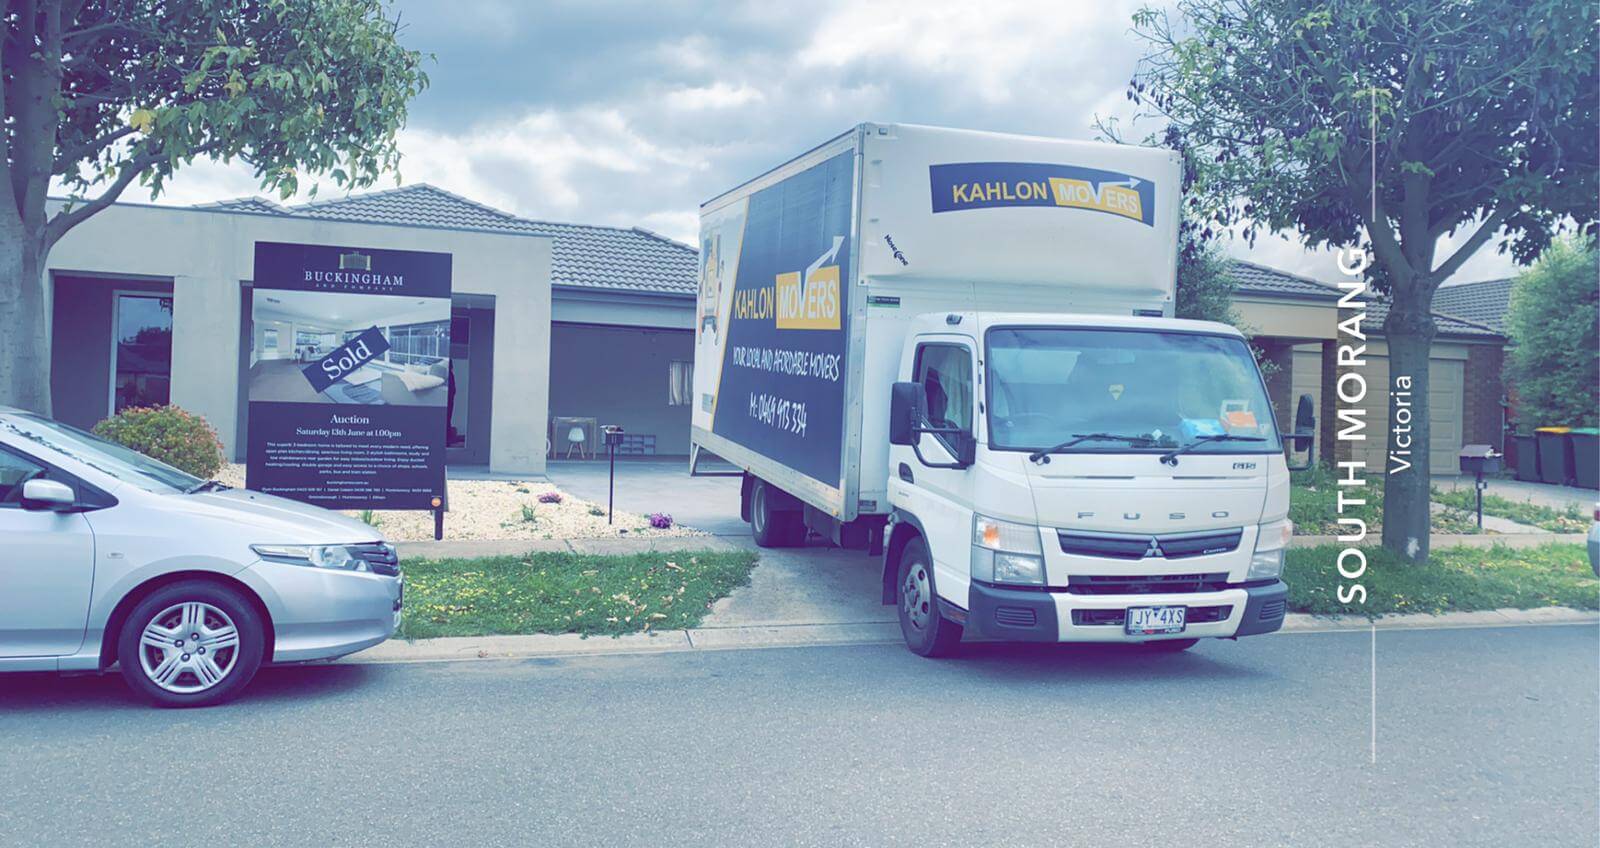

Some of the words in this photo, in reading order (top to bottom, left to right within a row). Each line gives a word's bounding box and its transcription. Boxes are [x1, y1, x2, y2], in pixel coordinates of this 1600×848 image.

[952, 181, 1048, 204] KAHLON
[1058, 182, 1138, 214] MOVERS
[305, 270, 404, 286] BUCKINGHAM
[734, 286, 774, 320] KAHLON
[779, 271, 836, 320] MOVERS
[322, 340, 372, 380] Sold
[732, 346, 746, 368] YOUR
[746, 347, 760, 368] LOCAL
[760, 348, 773, 371] AND
[809, 352, 841, 382] MOVERS
[330, 414, 370, 424] Auction
[749, 392, 758, 418] M:
[776, 398, 790, 430] 913
[791, 402, 807, 438] 334
[296, 427, 330, 437] Saturday
[1077, 511, 1230, 520] FUSO
